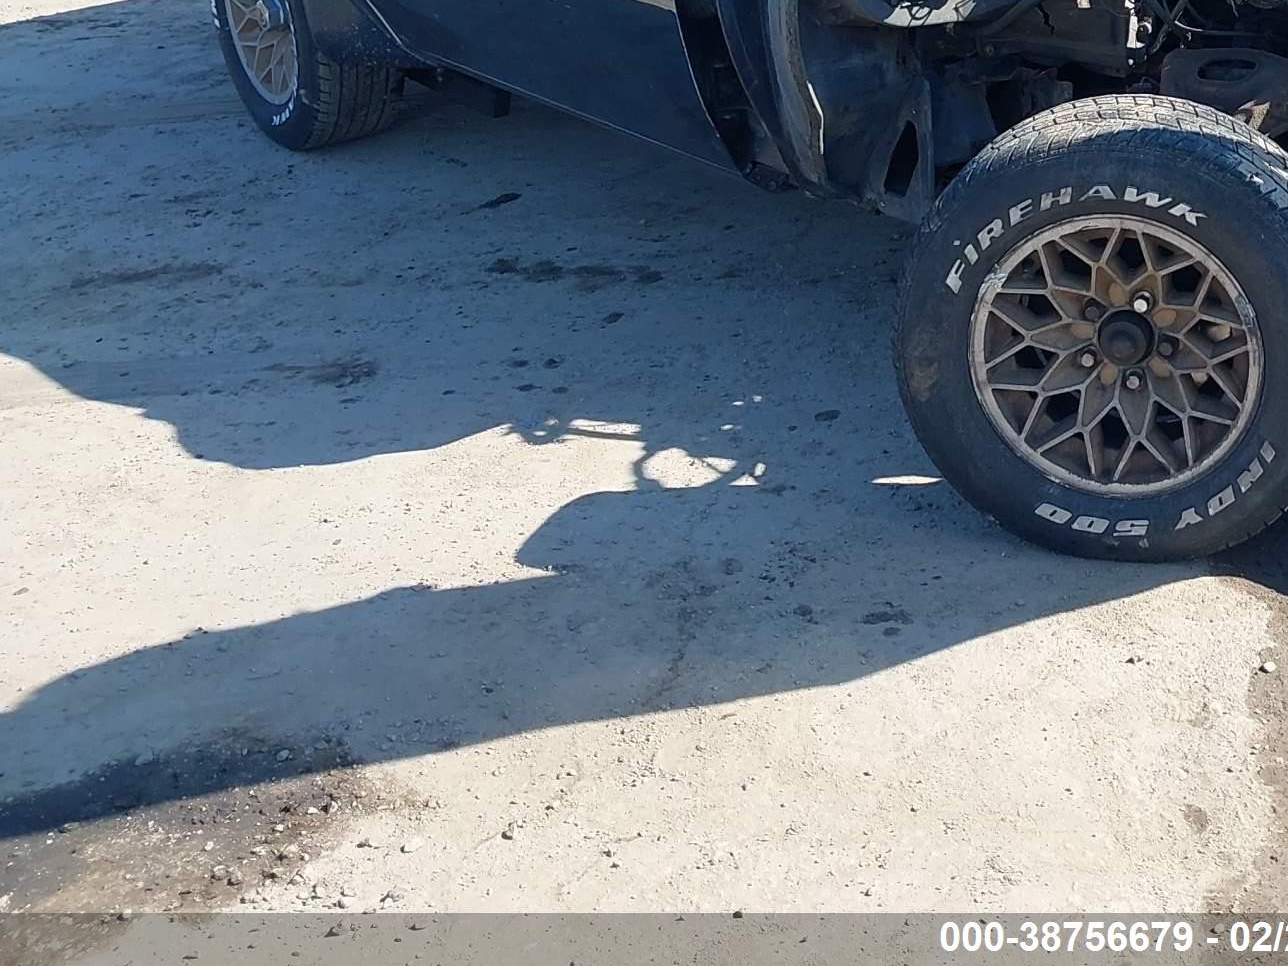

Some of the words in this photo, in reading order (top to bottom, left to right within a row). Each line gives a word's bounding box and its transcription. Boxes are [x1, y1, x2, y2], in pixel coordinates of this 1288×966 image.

[945, 185, 1208, 294] FIREHAWK
[1034, 502, 1150, 537] 500
[1174, 440, 1276, 530] INDY
